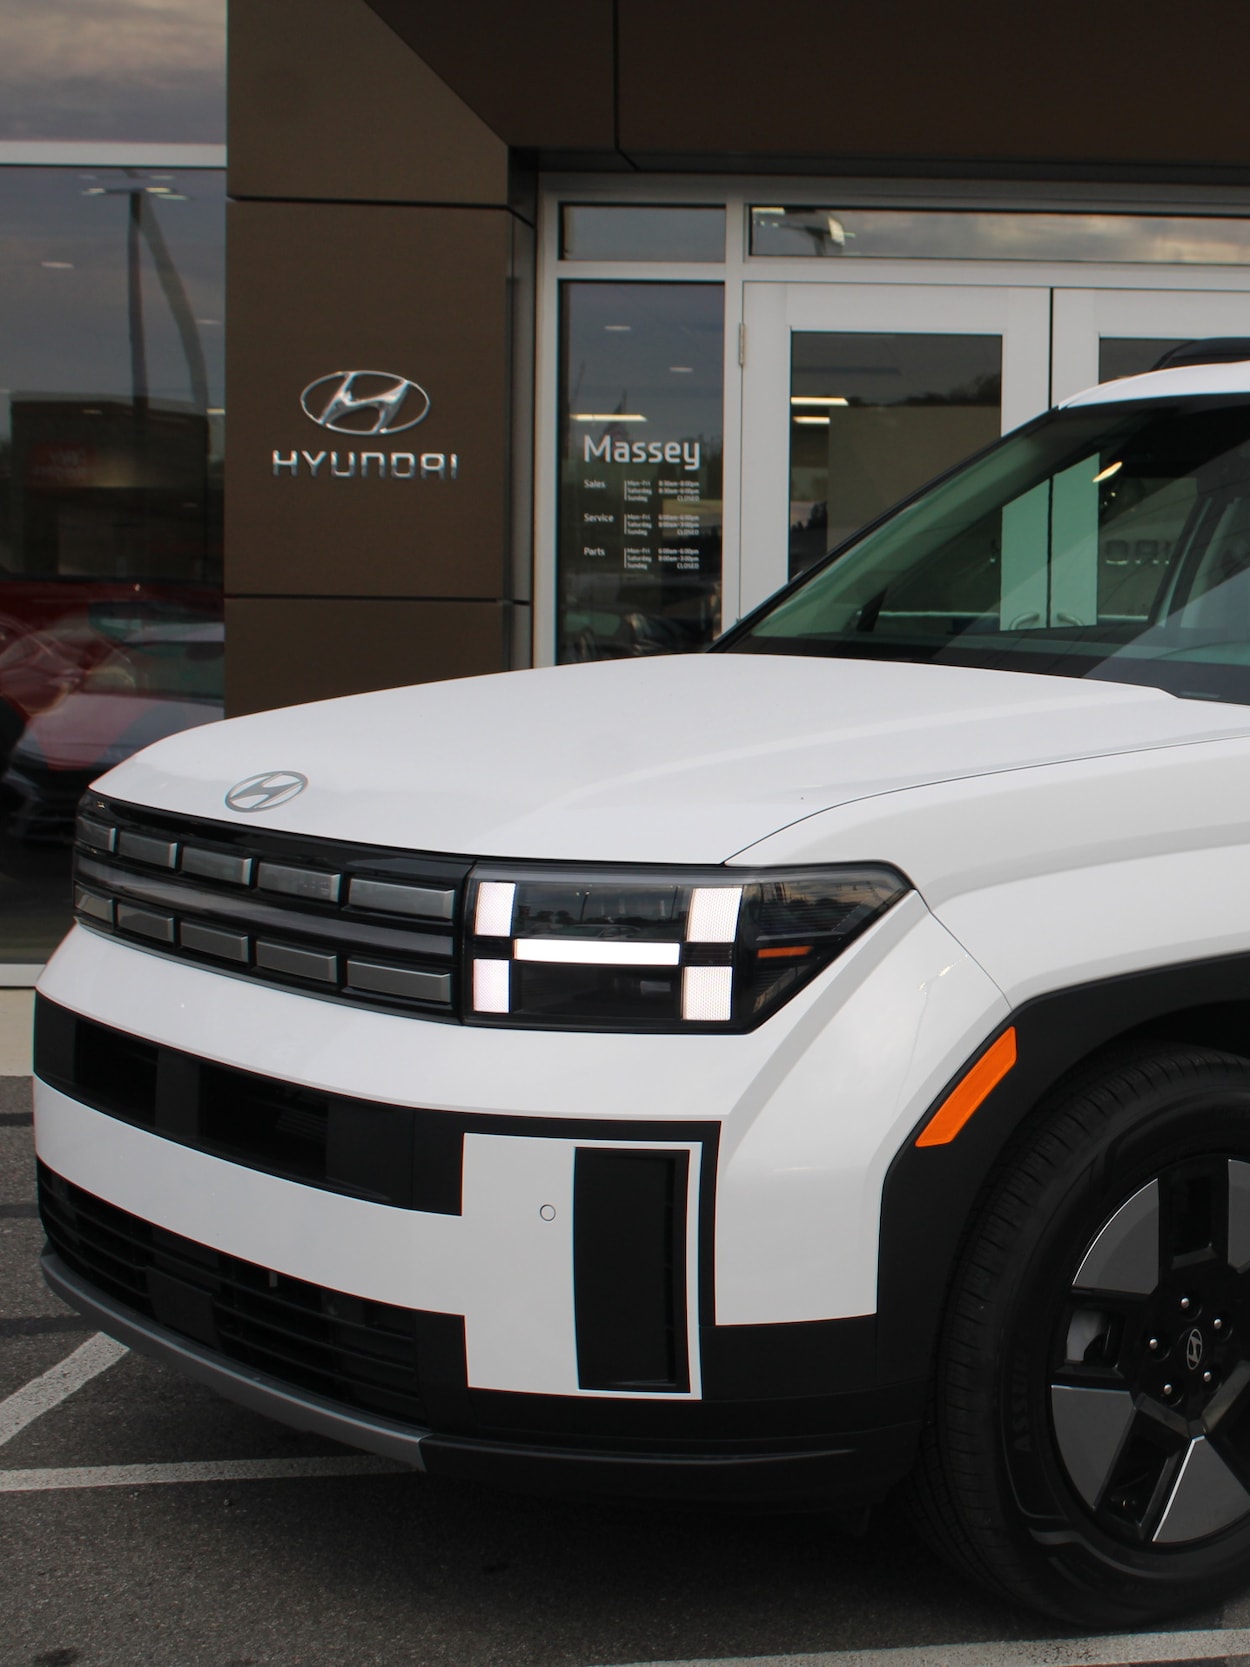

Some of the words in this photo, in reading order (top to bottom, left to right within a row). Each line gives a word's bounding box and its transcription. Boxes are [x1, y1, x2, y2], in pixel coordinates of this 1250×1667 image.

[584, 434, 701, 471] Massey
[271, 449, 459, 480] HYUNDAI
[584, 480, 606, 489] Sales
[584, 514, 615, 523] Service
[584, 547, 606, 556] Parts
